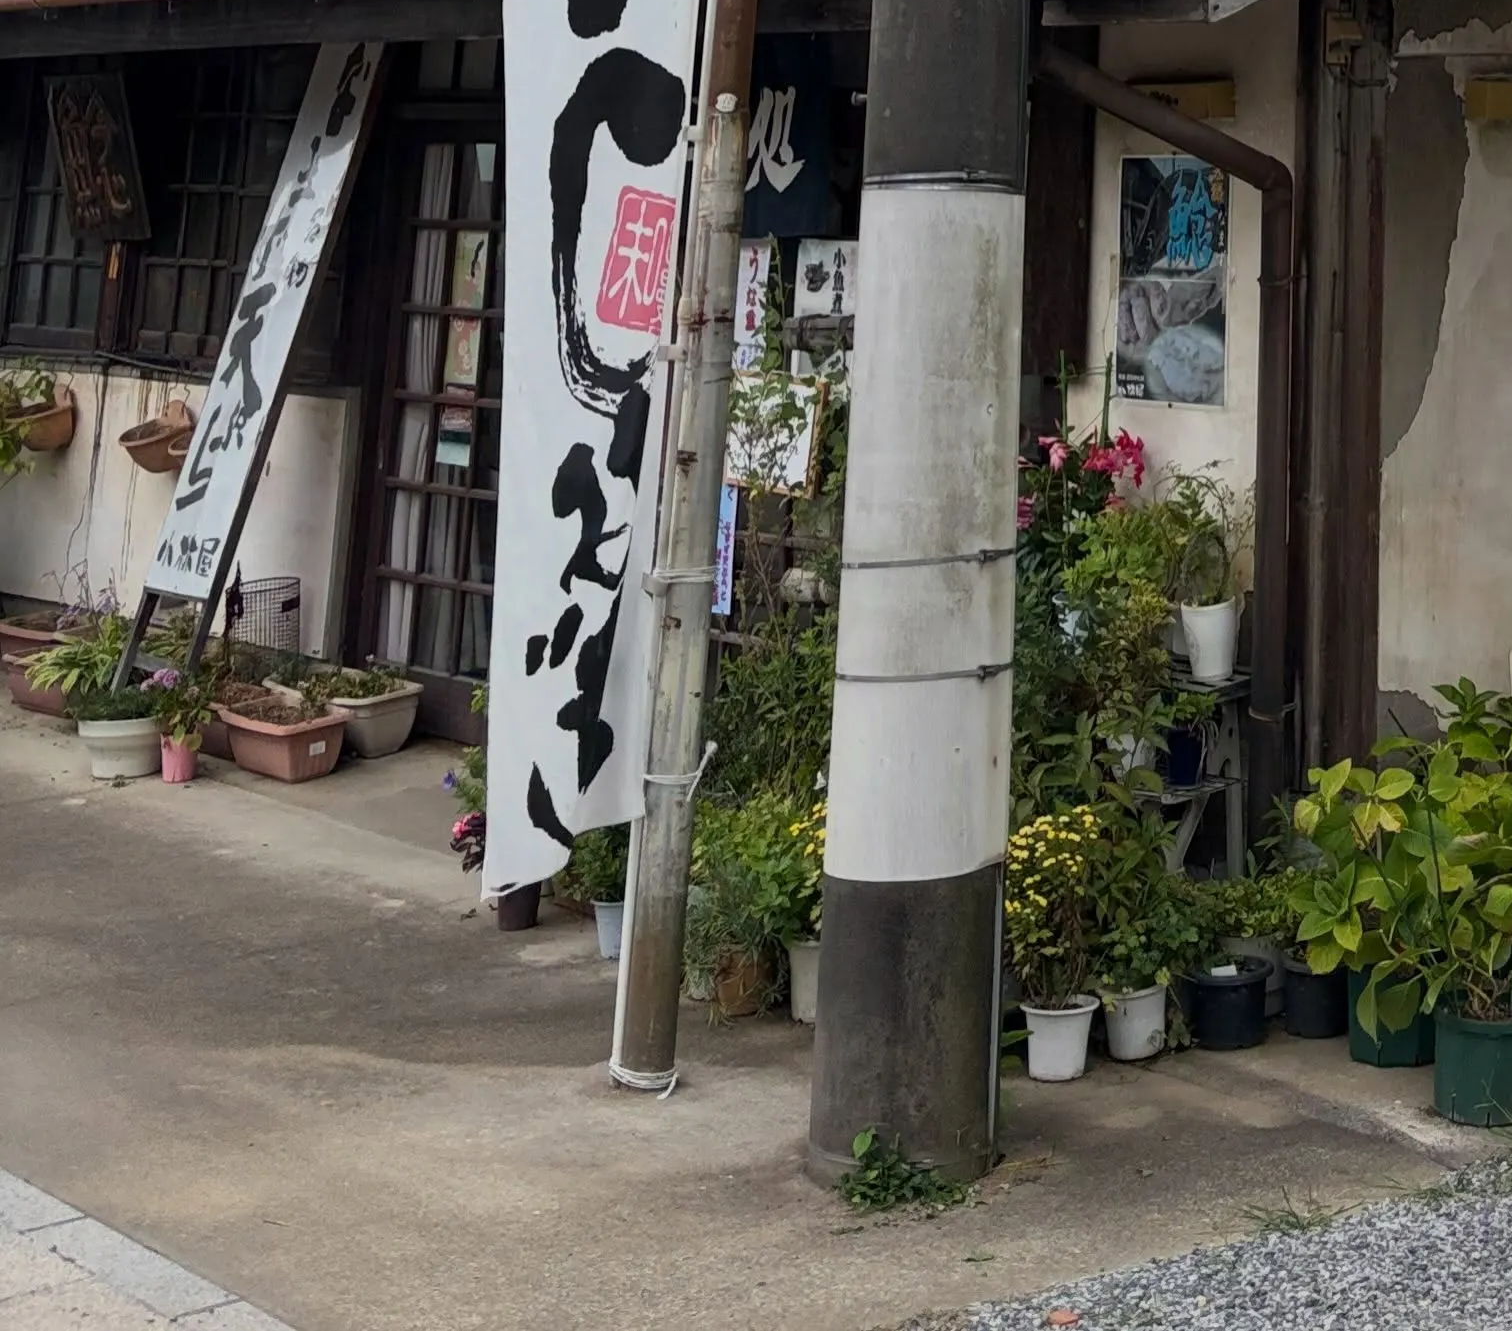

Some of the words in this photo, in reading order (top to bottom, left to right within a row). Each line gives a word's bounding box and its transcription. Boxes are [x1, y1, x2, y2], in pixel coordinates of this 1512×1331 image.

[745, 246, 759, 331] うな重
[830, 247, 847, 314] 小魚煮
